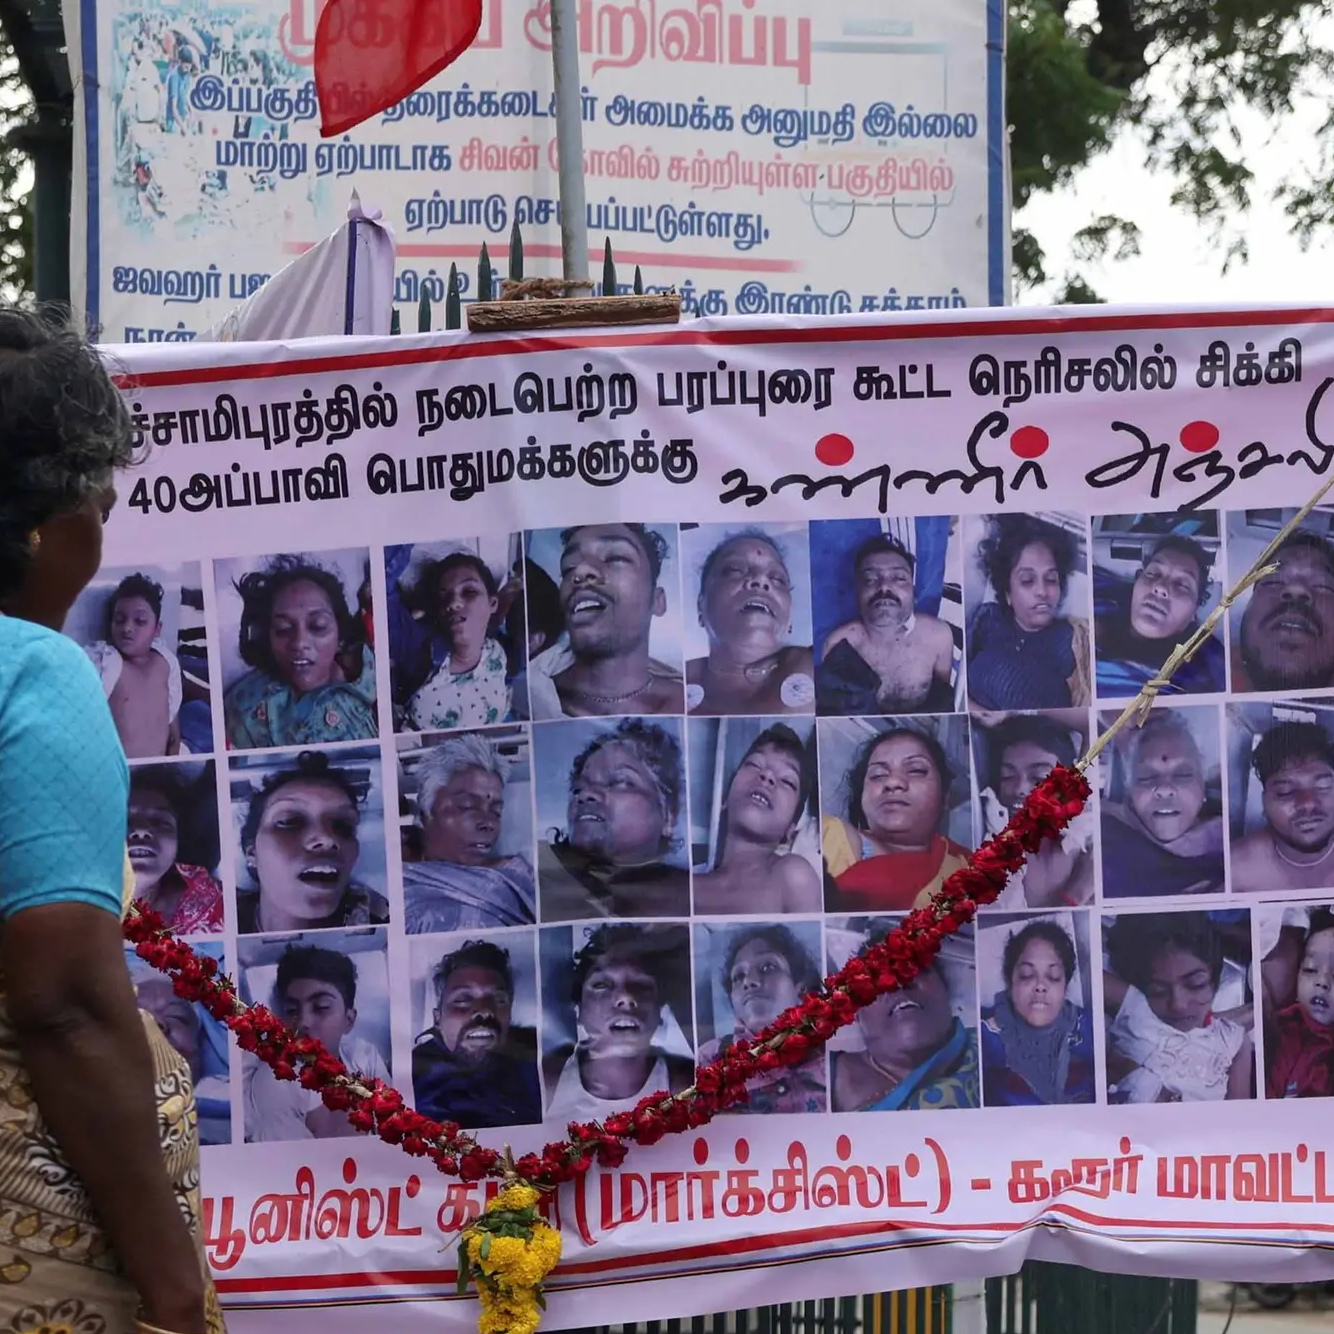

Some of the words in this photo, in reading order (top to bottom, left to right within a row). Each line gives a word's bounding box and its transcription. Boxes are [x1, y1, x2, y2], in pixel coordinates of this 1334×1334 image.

[605, 94, 733, 132] அமைக்க
[741, 103, 857, 148] அனுமதி
[863, 101, 978, 140] இல்லை
[215, 133, 307, 179] மாற்று
[315, 134, 452, 178] ஏற்பாடாக
[459, 136, 540, 172] சிவன்
[667, 147, 819, 197] சுற்றியுள்ள
[827, 156, 955, 198] பகுதியில்
[405, 190, 507, 234] ஏற்பாடு
[112, 264, 222, 306] ஜவஹர்
[130, 380, 398, 451] ச்சாமிபுரத்தில்
[417, 363, 639, 429] நடைபெற்ற
[657, 360, 835, 417] பரப்புரை
[852, 353, 952, 403] கூட்ட
[968, 343, 1177, 408] நெரிசலில்
[1195, 337, 1302, 388] சிக்கி
[128, 452, 350, 515] 40அப்பாவி
[366, 433, 699, 502] பொதுமக்களுக்கு
[202, 1156, 422, 1271] யூனிஸ்ட்
[574, 1132, 952, 1247] (மார்க்சிஸ்ட்)
